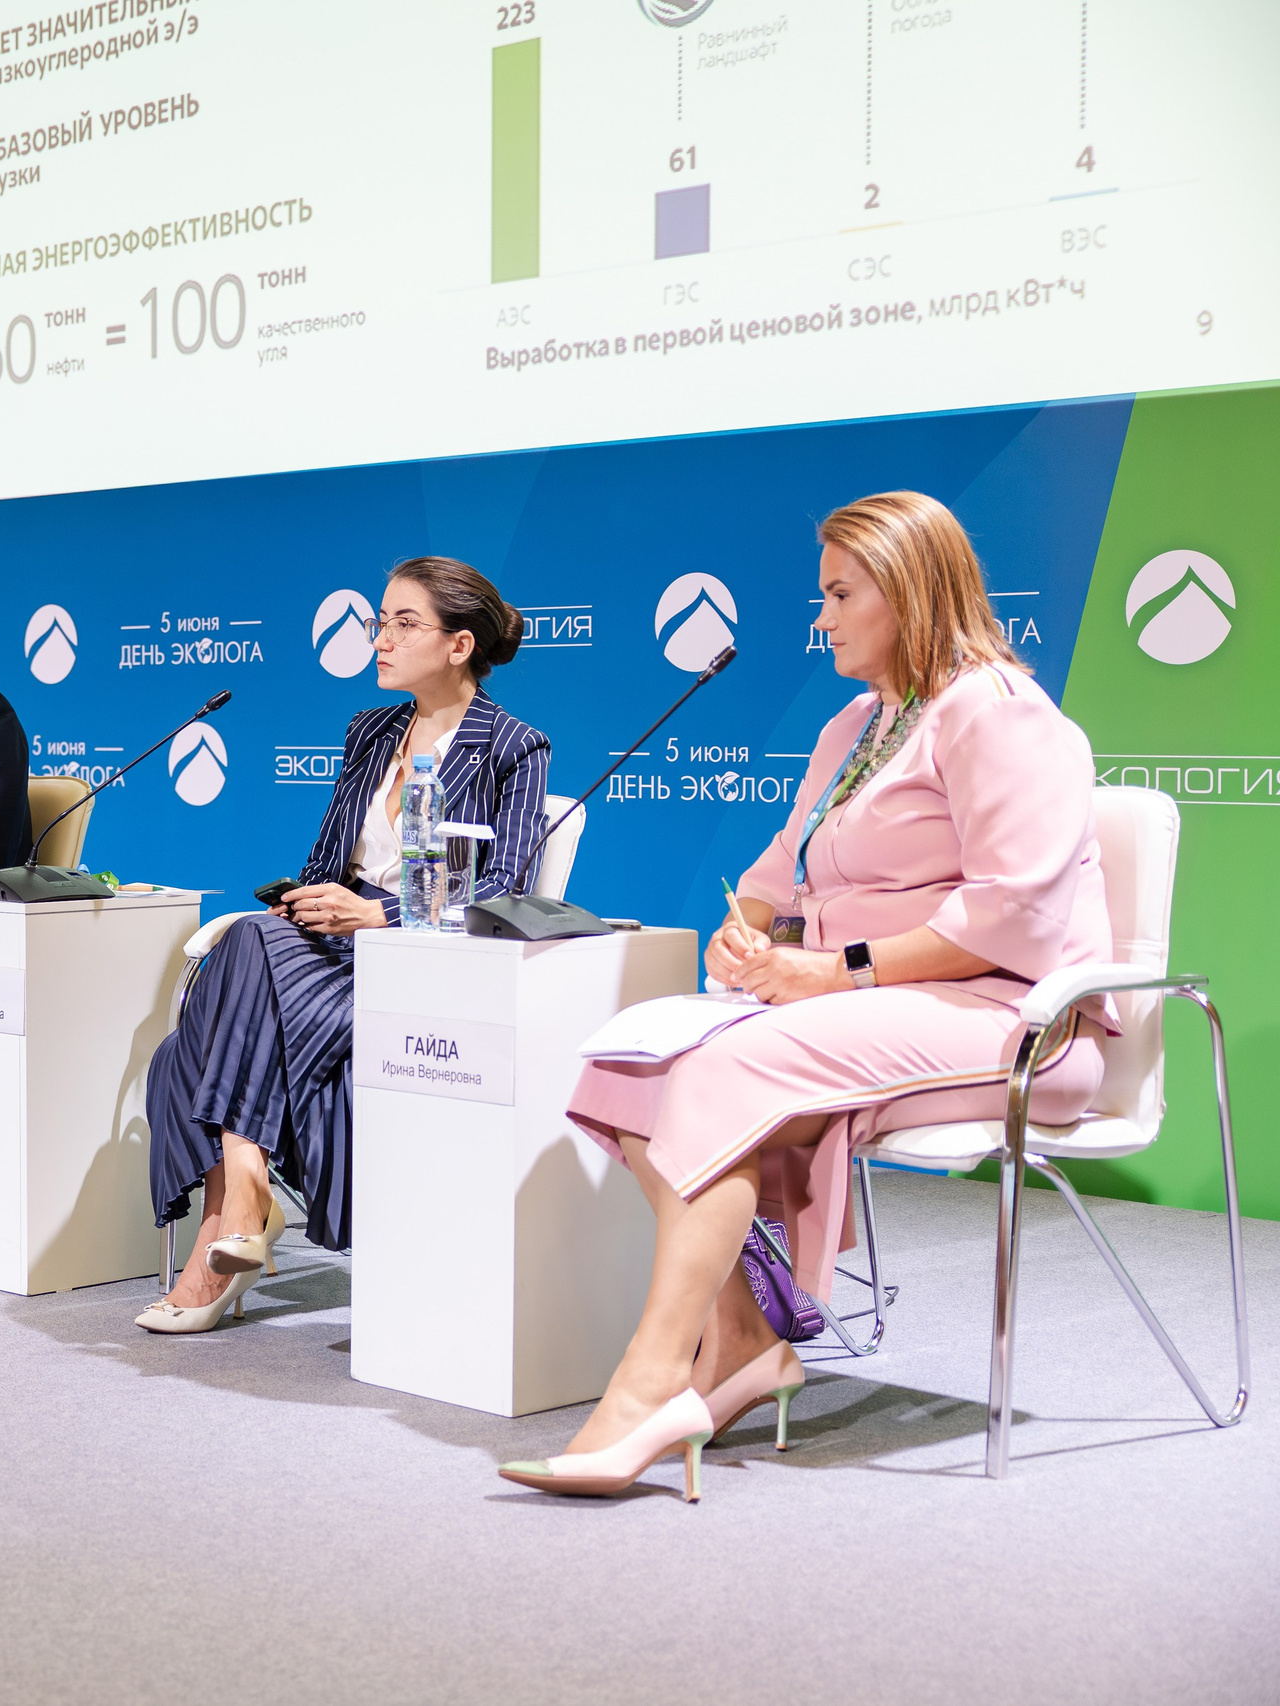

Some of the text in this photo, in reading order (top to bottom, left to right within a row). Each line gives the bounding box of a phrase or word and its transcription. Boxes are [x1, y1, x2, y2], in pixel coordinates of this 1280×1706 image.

[163, 9, 200, 44] э/э
[496, 2, 536, 31] 223
[697, 15, 788, 51] Равнинный
[696, 41, 778, 70] ландшафт
[100, 92, 200, 137] УРОВЕНЬ
[668, 145, 697, 173] 61
[1075, 144, 1096, 173] 4
[863, 182, 881, 210] 2
[32, 196, 314, 272] ЭНЕРГОЭФФЕКТИВНОСТЬ
[1060, 224, 1108, 254] ВЭС
[257, 265, 307, 291] тонн
[847, 254, 893, 282] СЭС
[662, 281, 700, 306] ГЭС
[44, 306, 87, 329] тонн
[139, 272, 247, 360] 100
[257, 309, 367, 340] качественного
[495, 304, 532, 328] АЭС
[1196, 310, 1214, 337] 9
[486, 338, 610, 373] Выработка
[614, 336, 627, 356] в
[634, 318, 724, 356] первой
[729, 303, 843, 346] ценовой
[850, 300, 923, 329] зоне,
[929, 288, 1001, 320] млрд
[46, 355, 85, 378] нефти
[257, 344, 288, 368] угля
[160, 611, 220, 634] 5 июня
[119, 637, 264, 670] ДЕНЬ ЭКОЛОГА
[32, 734, 86, 756] 5 июня
[665, 737, 749, 763] 5 июня
[606, 774, 671, 803] ДЕНЬ
[405, 1032, 459, 1061] ГАЙДА
[382, 1059, 482, 1086] Ирина Вернеровна
